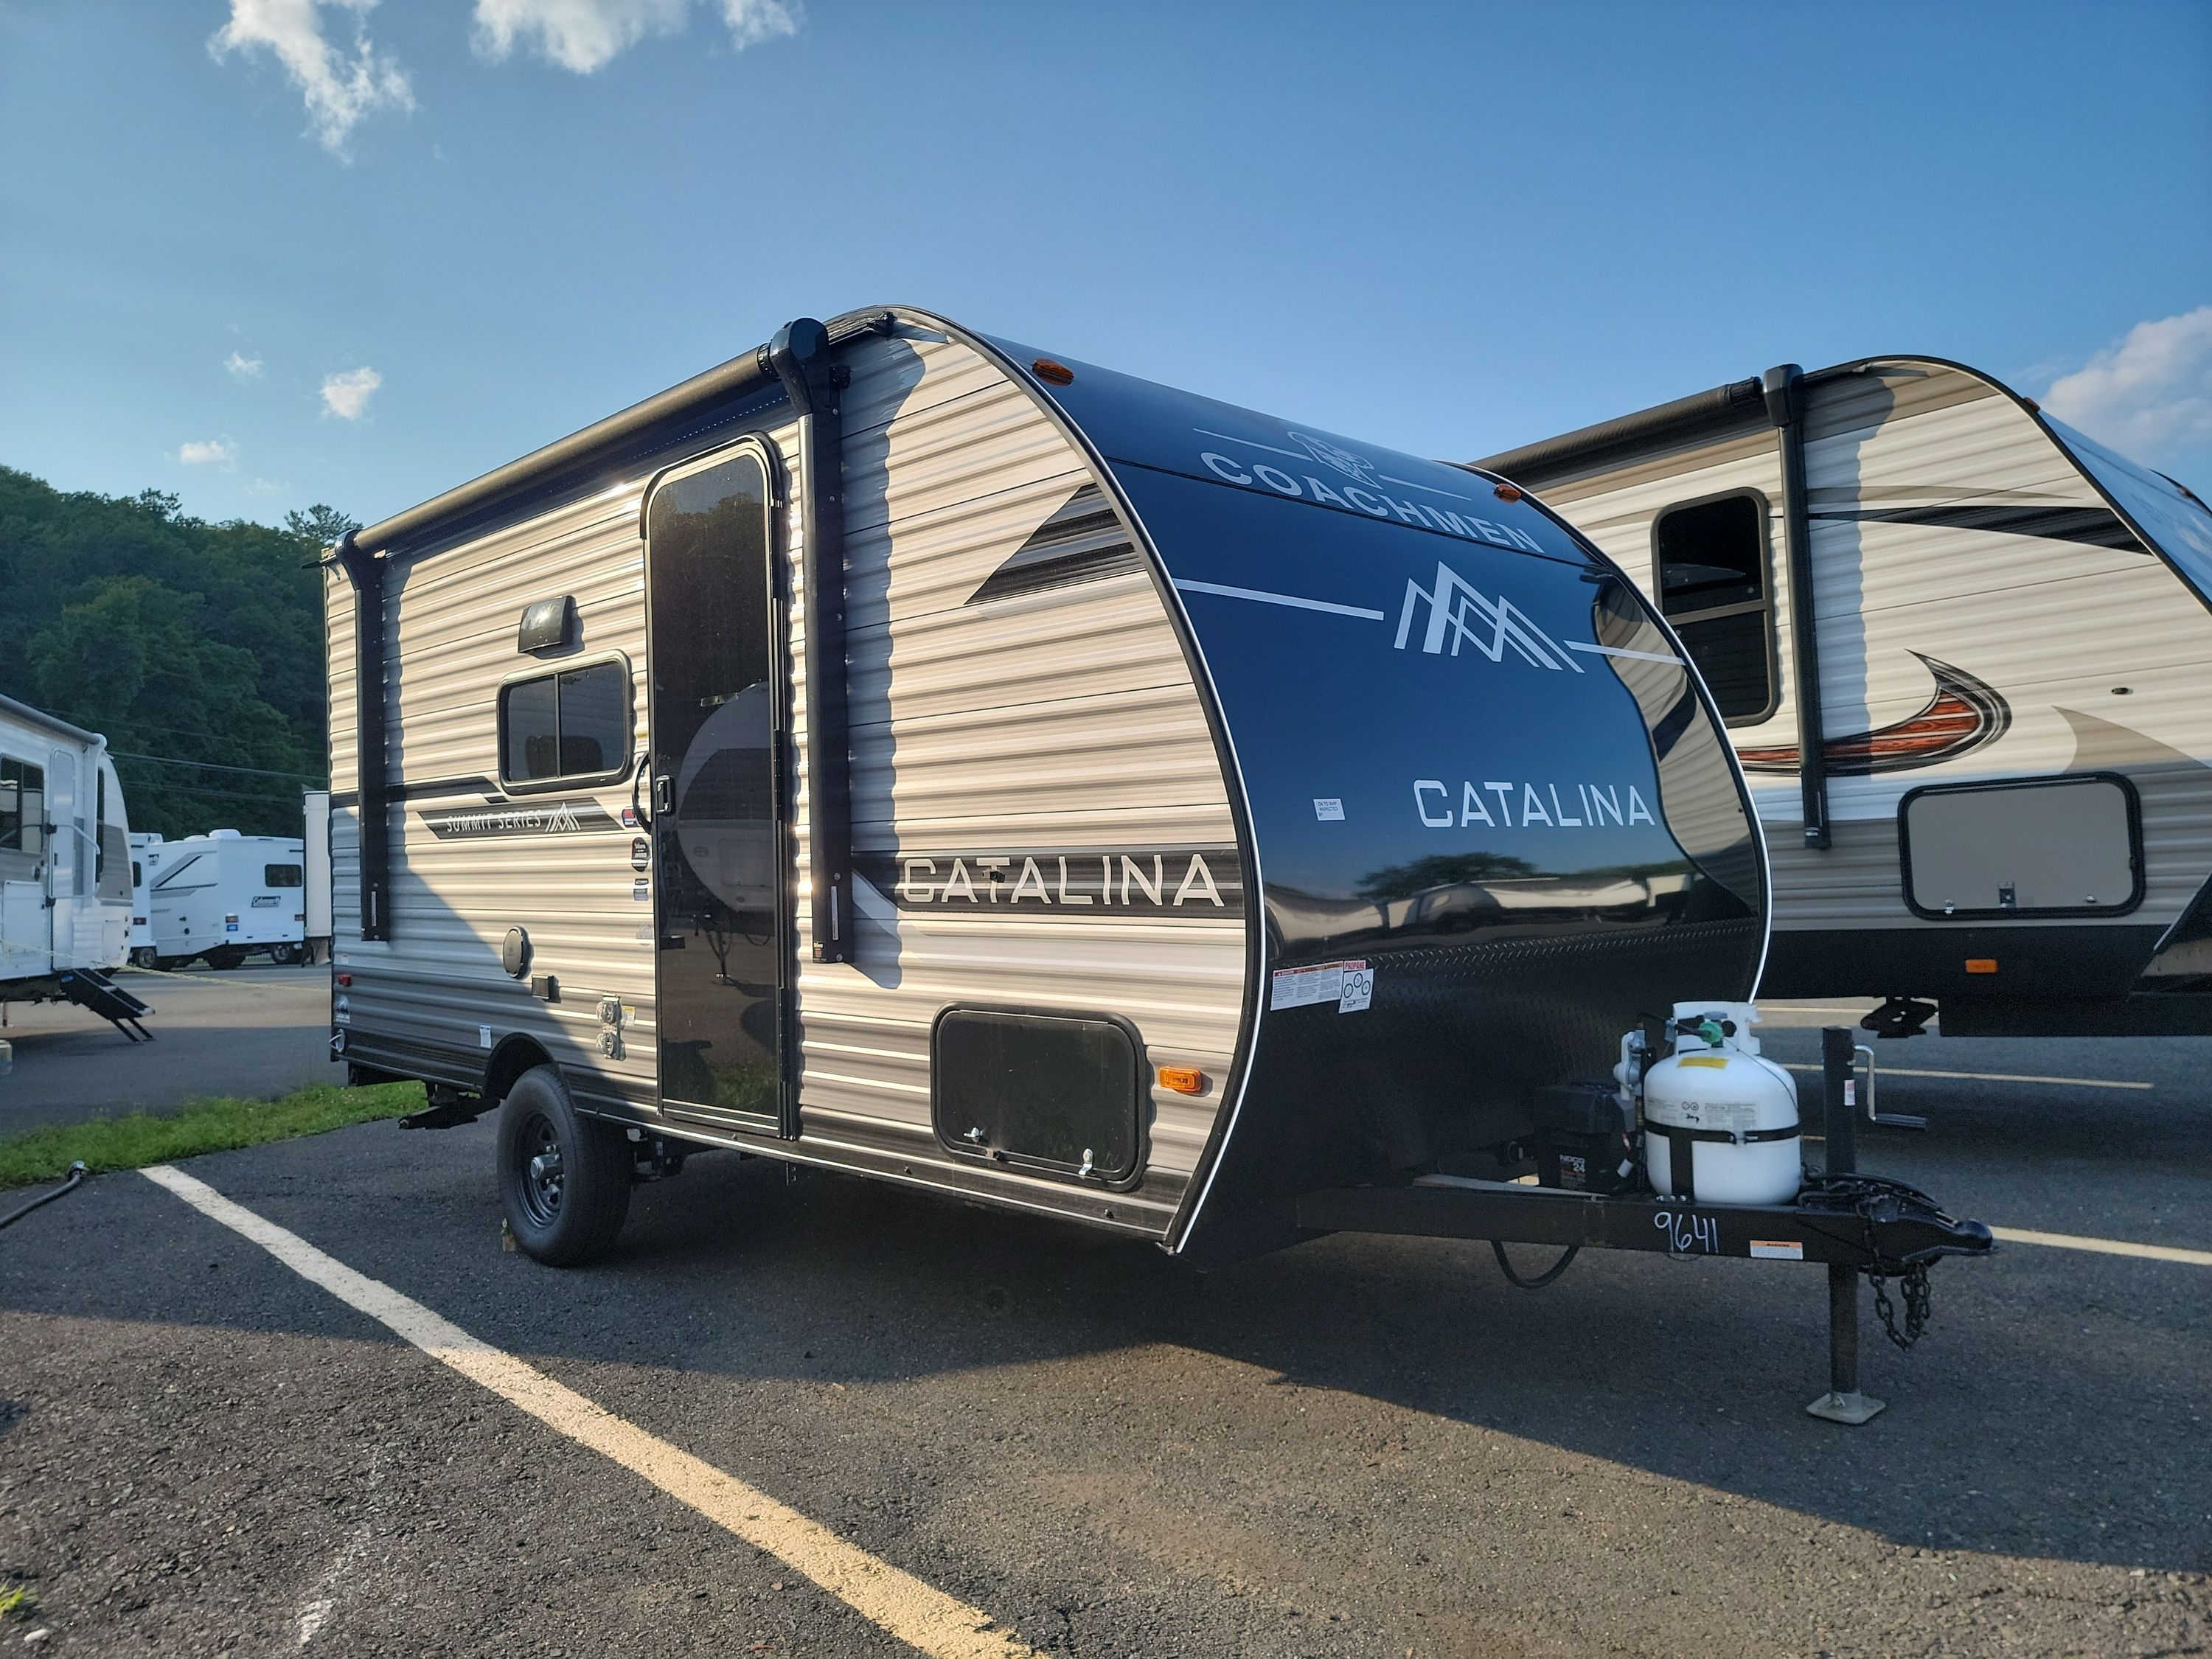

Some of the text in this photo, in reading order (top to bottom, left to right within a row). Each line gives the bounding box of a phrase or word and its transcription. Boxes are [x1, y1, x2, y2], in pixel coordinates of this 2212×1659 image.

[1200, 452, 1545, 553] COACHMEN
[447, 810, 542, 833] SUMMIT SERIES
[1413, 779, 1655, 827] CATALINA
[904, 853, 1225, 907] CATALINA
[1344, 961, 1366, 970] PROPANE
[1654, 1211, 1719, 1253] 9641
